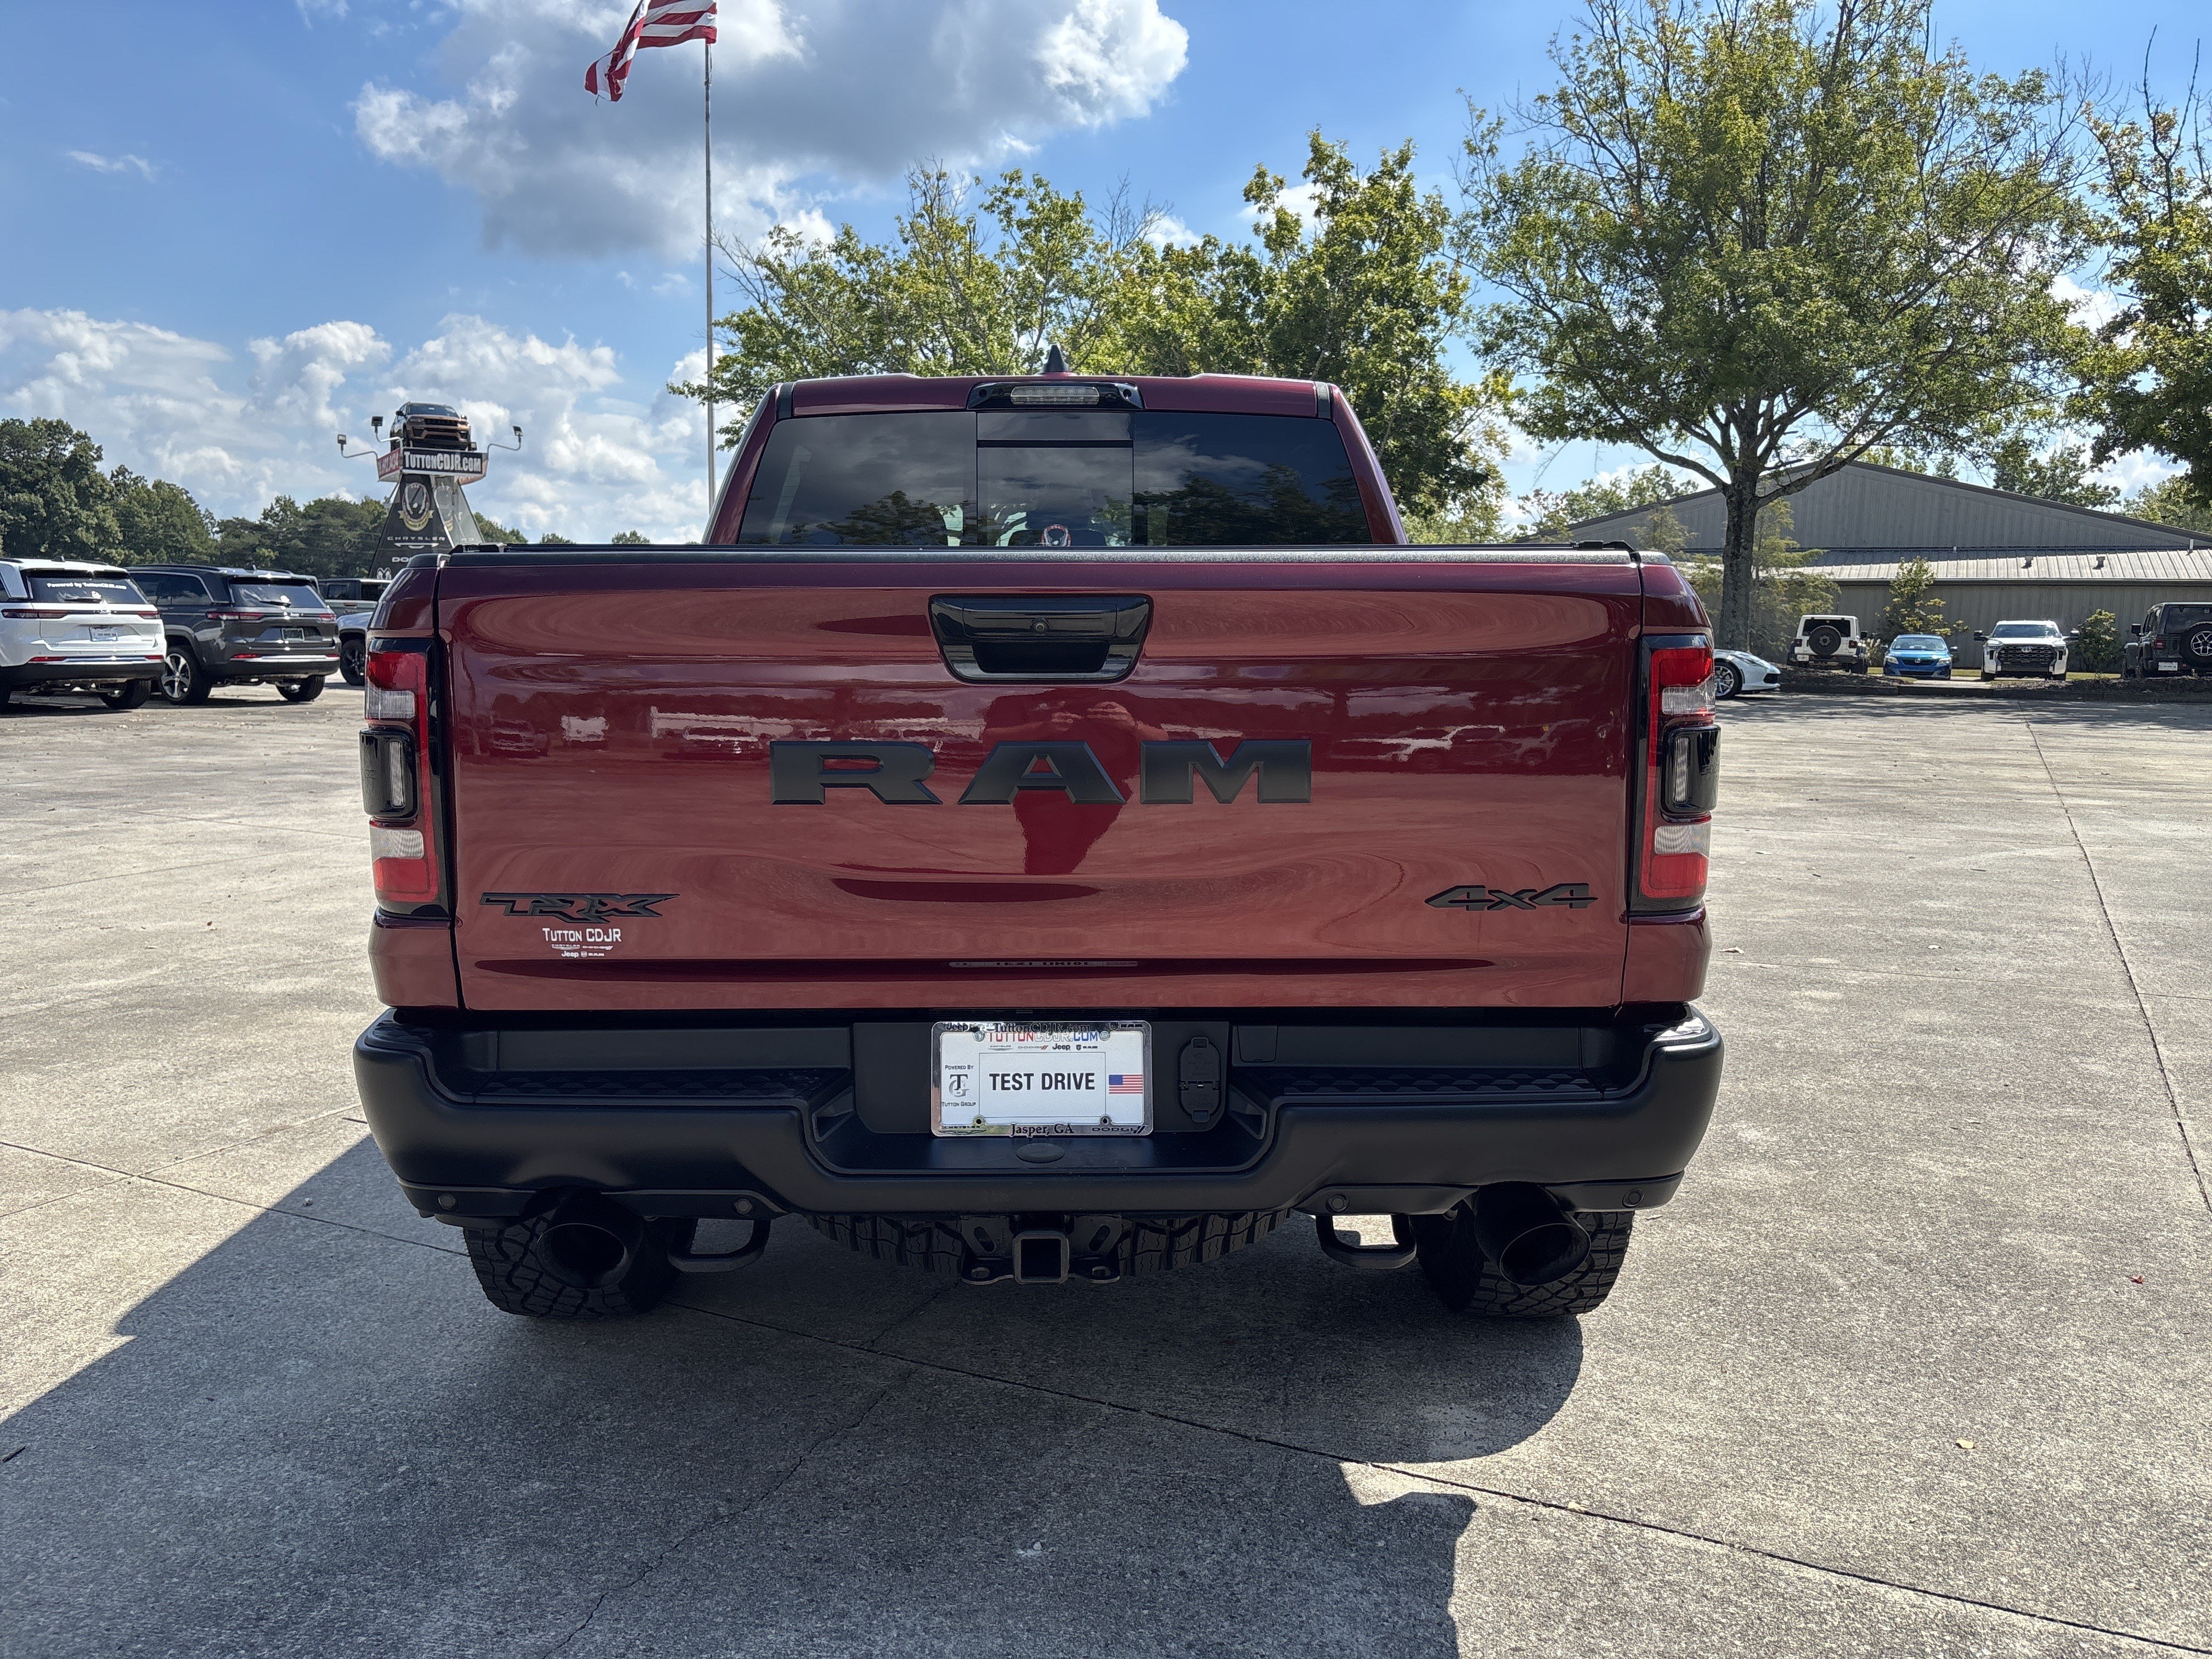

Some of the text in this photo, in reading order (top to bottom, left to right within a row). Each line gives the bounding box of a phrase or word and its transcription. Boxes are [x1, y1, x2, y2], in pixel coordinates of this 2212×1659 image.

[769, 740, 1312, 805] RAM
[479, 892, 680, 924] TRX
[586, 928, 622, 942] CDJR
[946, 1022, 969, 1031] Jeep
[989, 1073, 1095, 1091] TEST DRIVE
[1011, 1124, 1075, 1137] Jasper, GA
